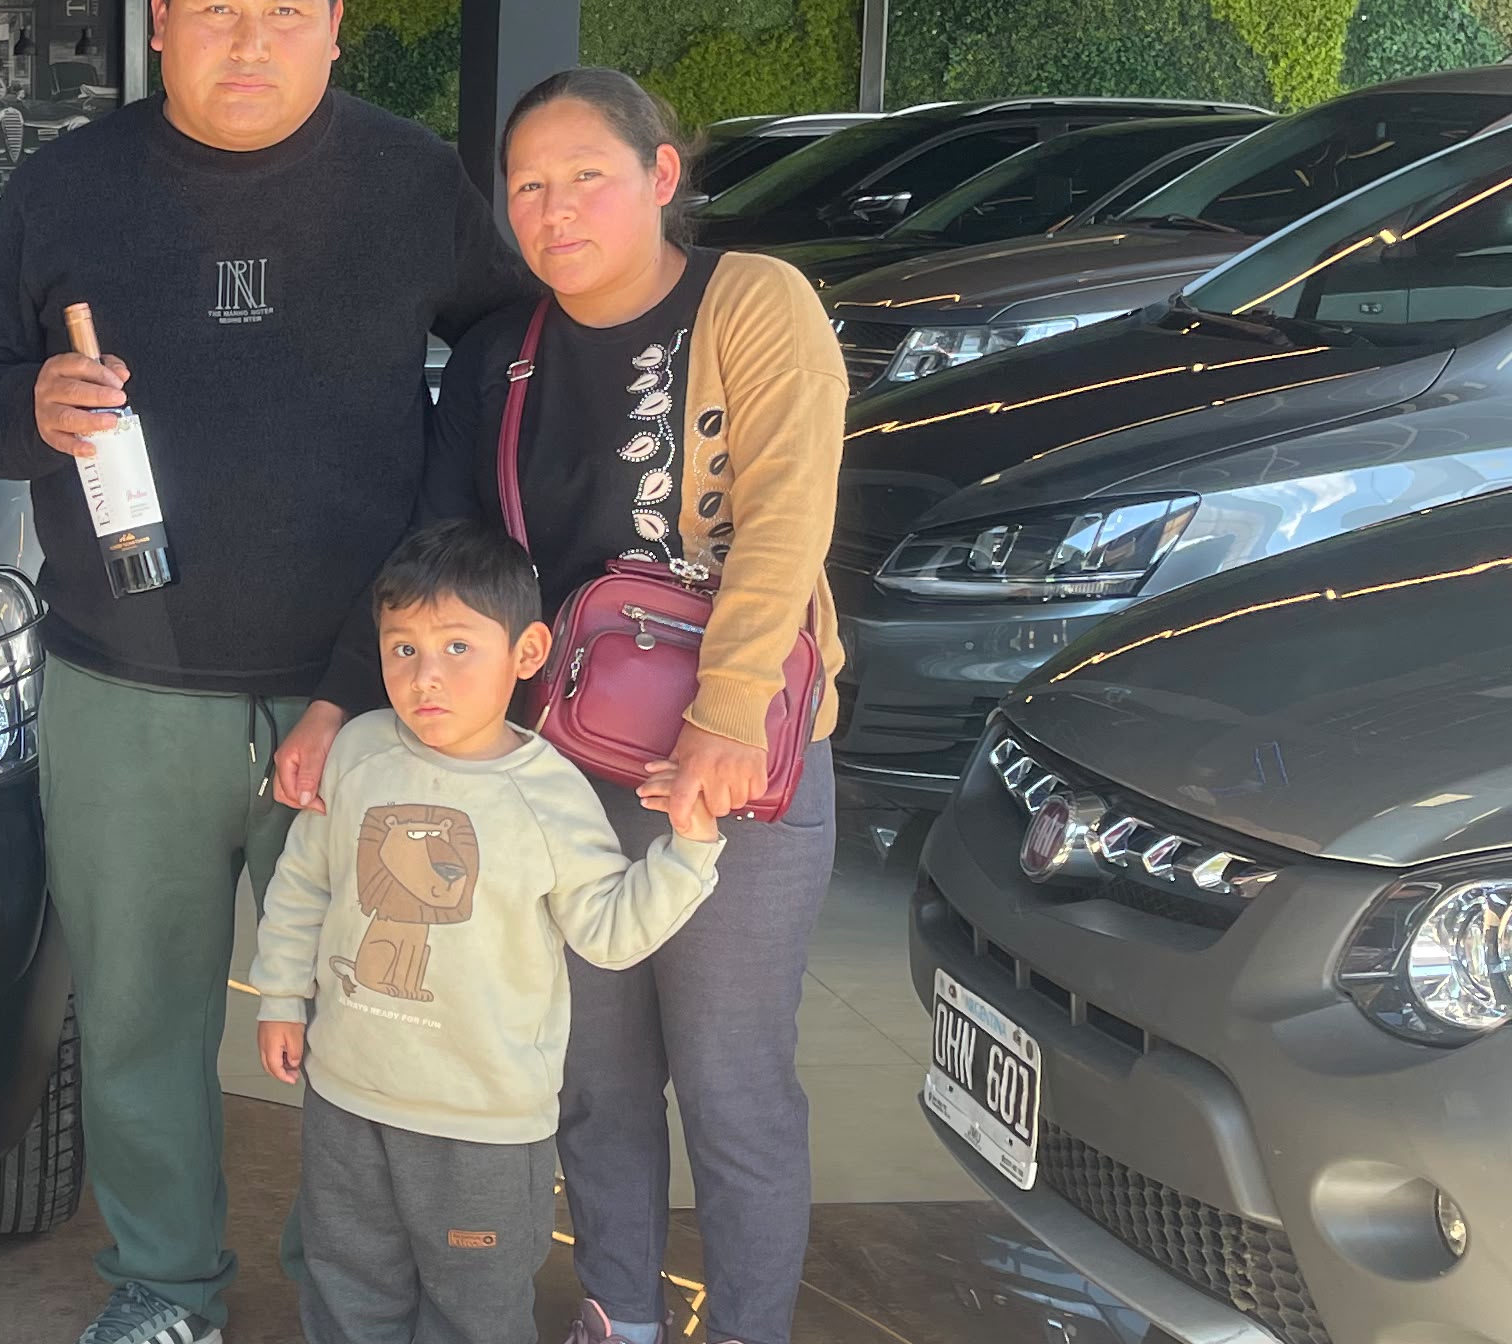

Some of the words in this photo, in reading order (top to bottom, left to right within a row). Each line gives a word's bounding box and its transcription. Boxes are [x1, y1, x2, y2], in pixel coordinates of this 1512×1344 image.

[84, 462, 111, 527] EMILI
[370, 1006, 400, 1020] READY
[401, 1014, 420, 1025] FOR
[422, 1018, 442, 1029] FUN
[986, 1044, 1030, 1140] 601
